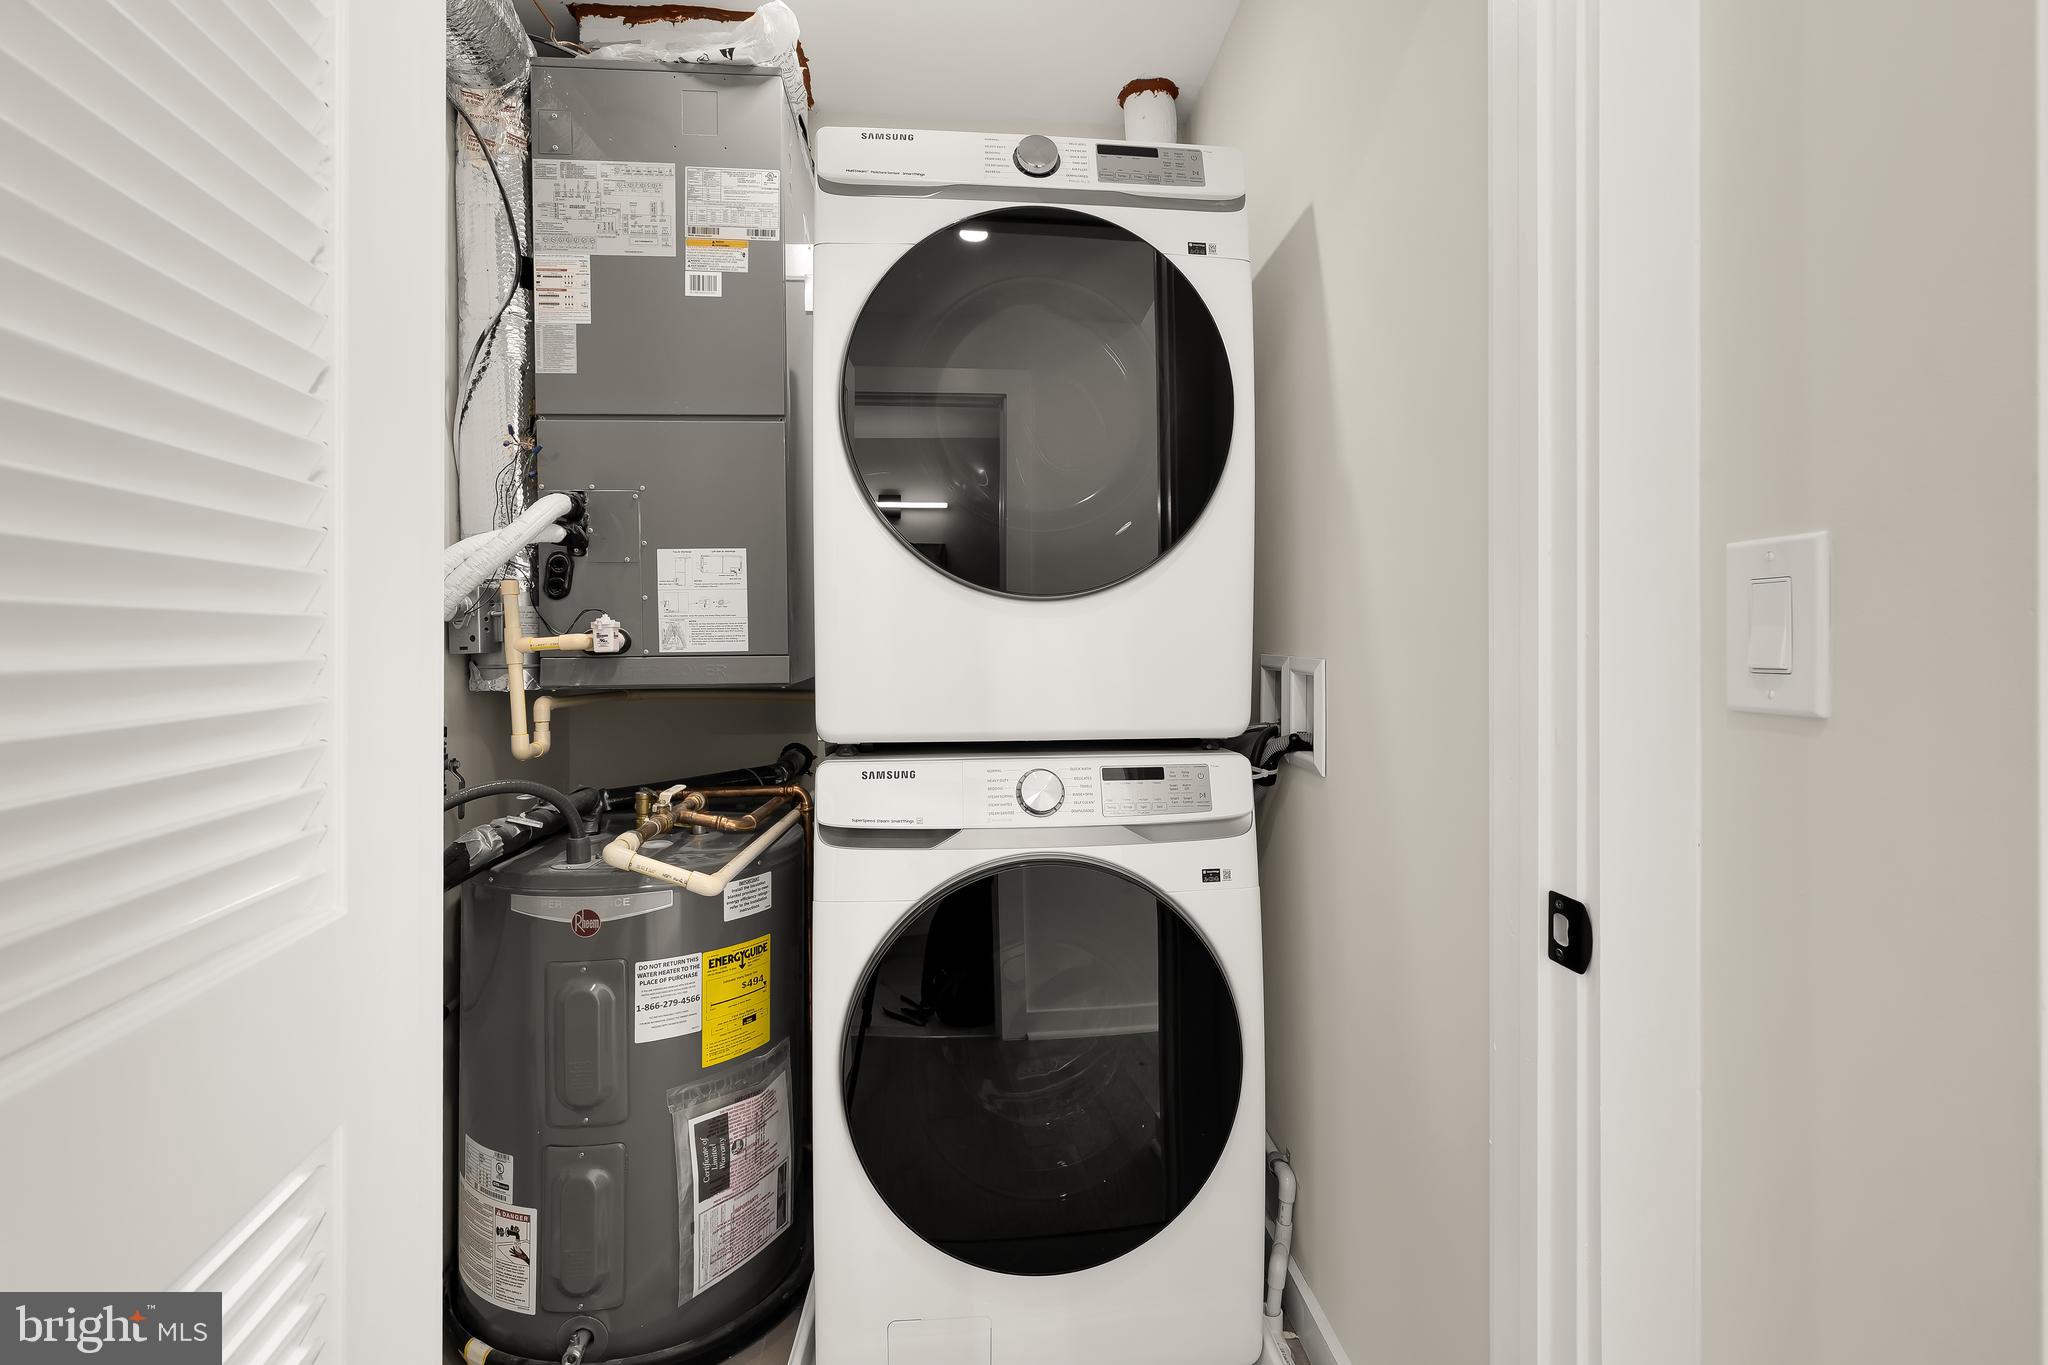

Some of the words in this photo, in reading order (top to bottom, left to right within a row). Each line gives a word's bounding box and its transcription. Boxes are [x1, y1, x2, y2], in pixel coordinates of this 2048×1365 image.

[860, 132, 914, 141] SAMSUNG
[861, 770, 916, 780] SAMSUNG
[574, 909, 599, 933] Rheem
[708, 942, 768, 969] ENERGYGUIDE
[662, 959, 686, 968] RETURN
[658, 966, 680, 976] HEATER
[668, 971, 698, 981] PURCHASE
[741, 974, 764, 989] $494
[636, 994, 700, 1012] 1-866-279-4566
[700, 1137, 709, 1145] of
[709, 1144, 718, 1170] Limited
[702, 1147, 711, 1183] Certificate
[502, 1211, 528, 1222] DANGER
